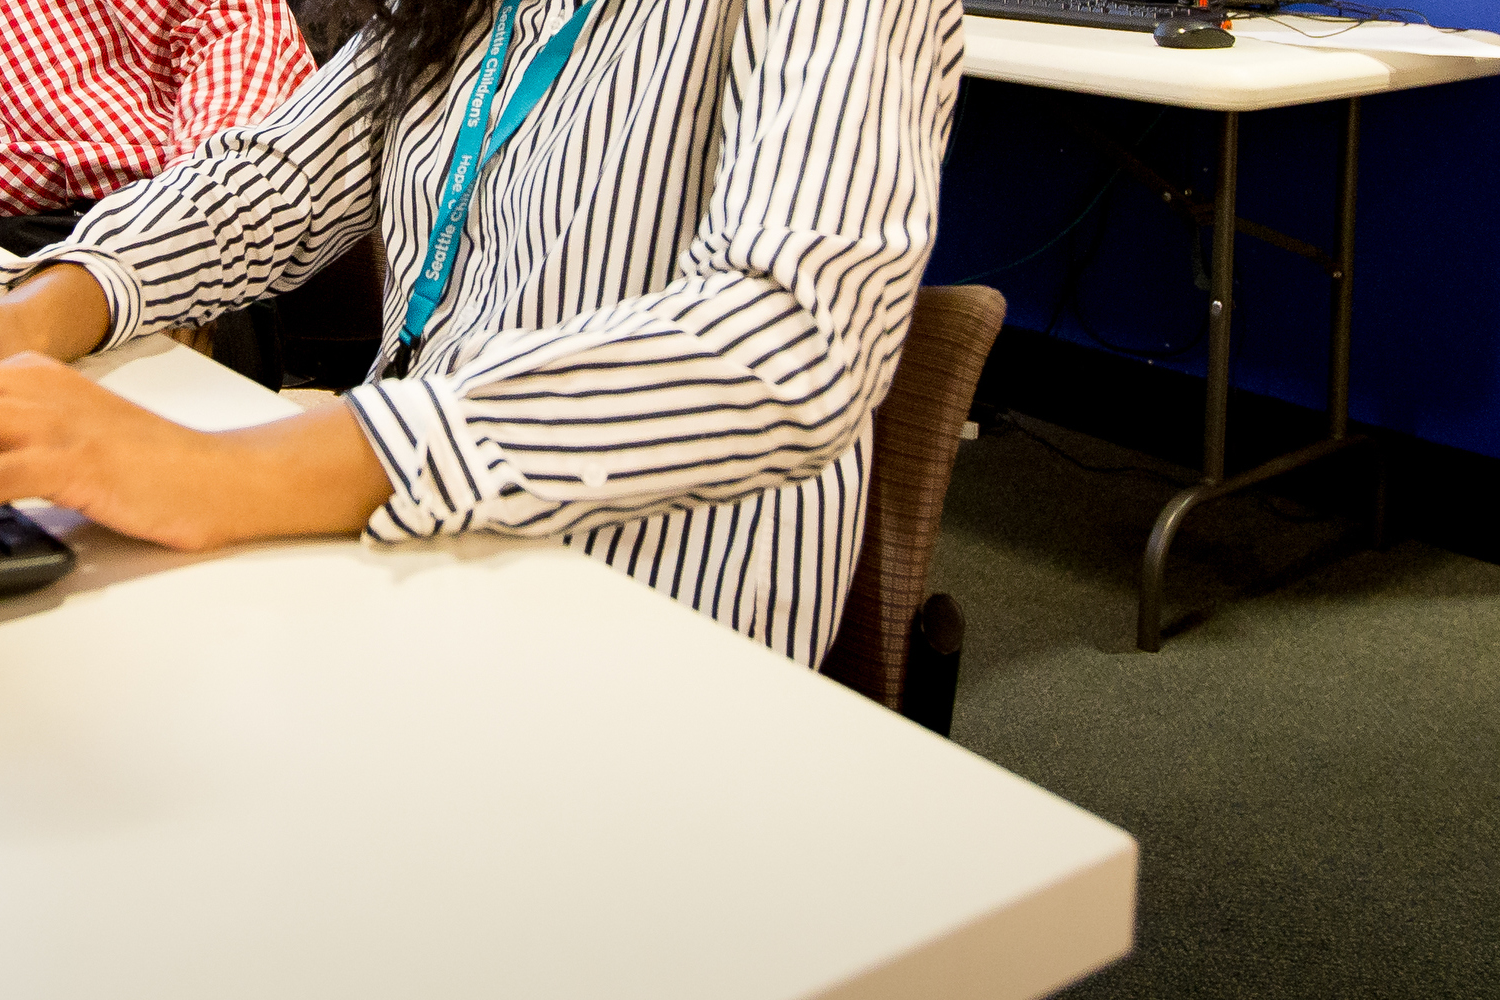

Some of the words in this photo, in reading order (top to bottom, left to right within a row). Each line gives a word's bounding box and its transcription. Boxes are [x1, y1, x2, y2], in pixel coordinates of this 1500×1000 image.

[490, 5, 513, 56] Seattle
[467, 57, 498, 128] Children's
[425, 224, 456, 282] Seattle
